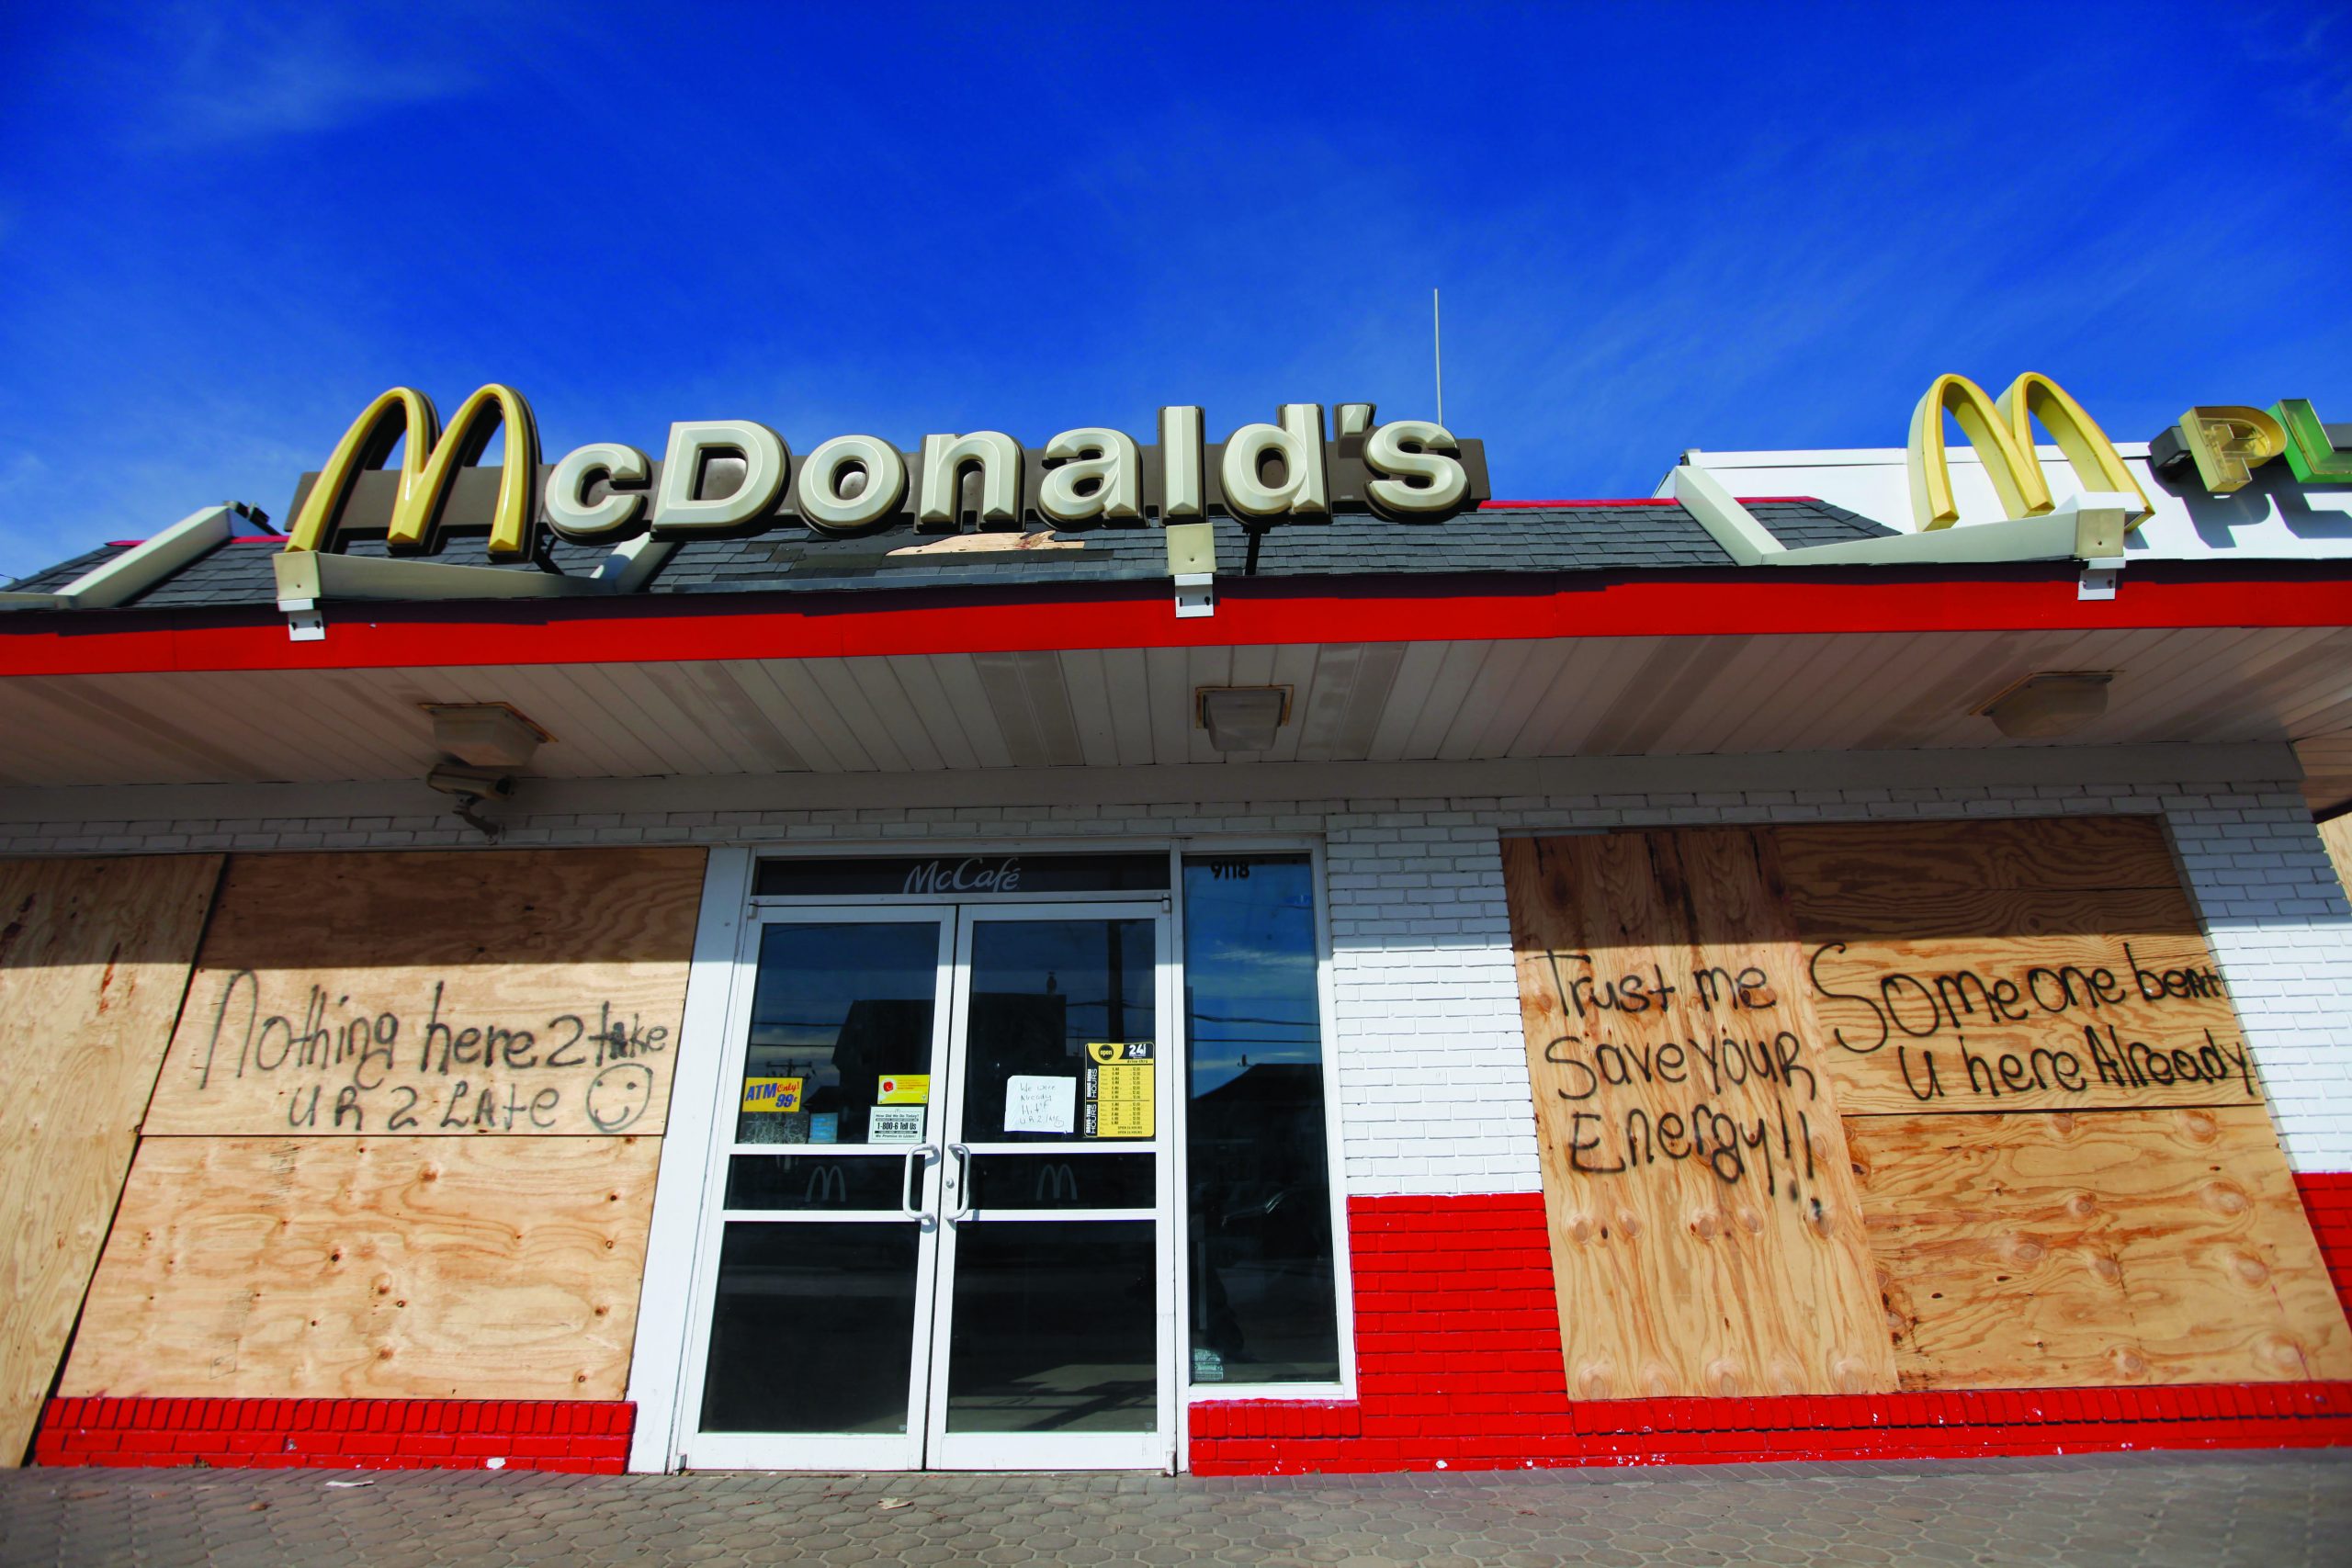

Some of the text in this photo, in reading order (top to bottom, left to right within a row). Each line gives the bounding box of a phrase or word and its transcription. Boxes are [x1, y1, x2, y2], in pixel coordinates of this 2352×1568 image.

[285, 383, 1472, 555] McDonald's
[903, 856, 1021, 894] McCafé
[1210, 861, 1250, 880] 9118
[1524, 949, 1777, 1018] Trust me
[421, 980, 538, 1075] here
[546, 1014, 588, 1069] 2
[1544, 1035, 1688, 1100] Save
[1958, 1035, 2087, 1098] here
[2083, 1024, 2256, 1097] Already
[334, 1086, 363, 1131] R
[388, 1087, 420, 1131] 2
[745, 1083, 777, 1101] ATM
[1020, 1082, 1032, 1092] We
[877, 1122, 917, 1131] 1-800-6 Tell Us
